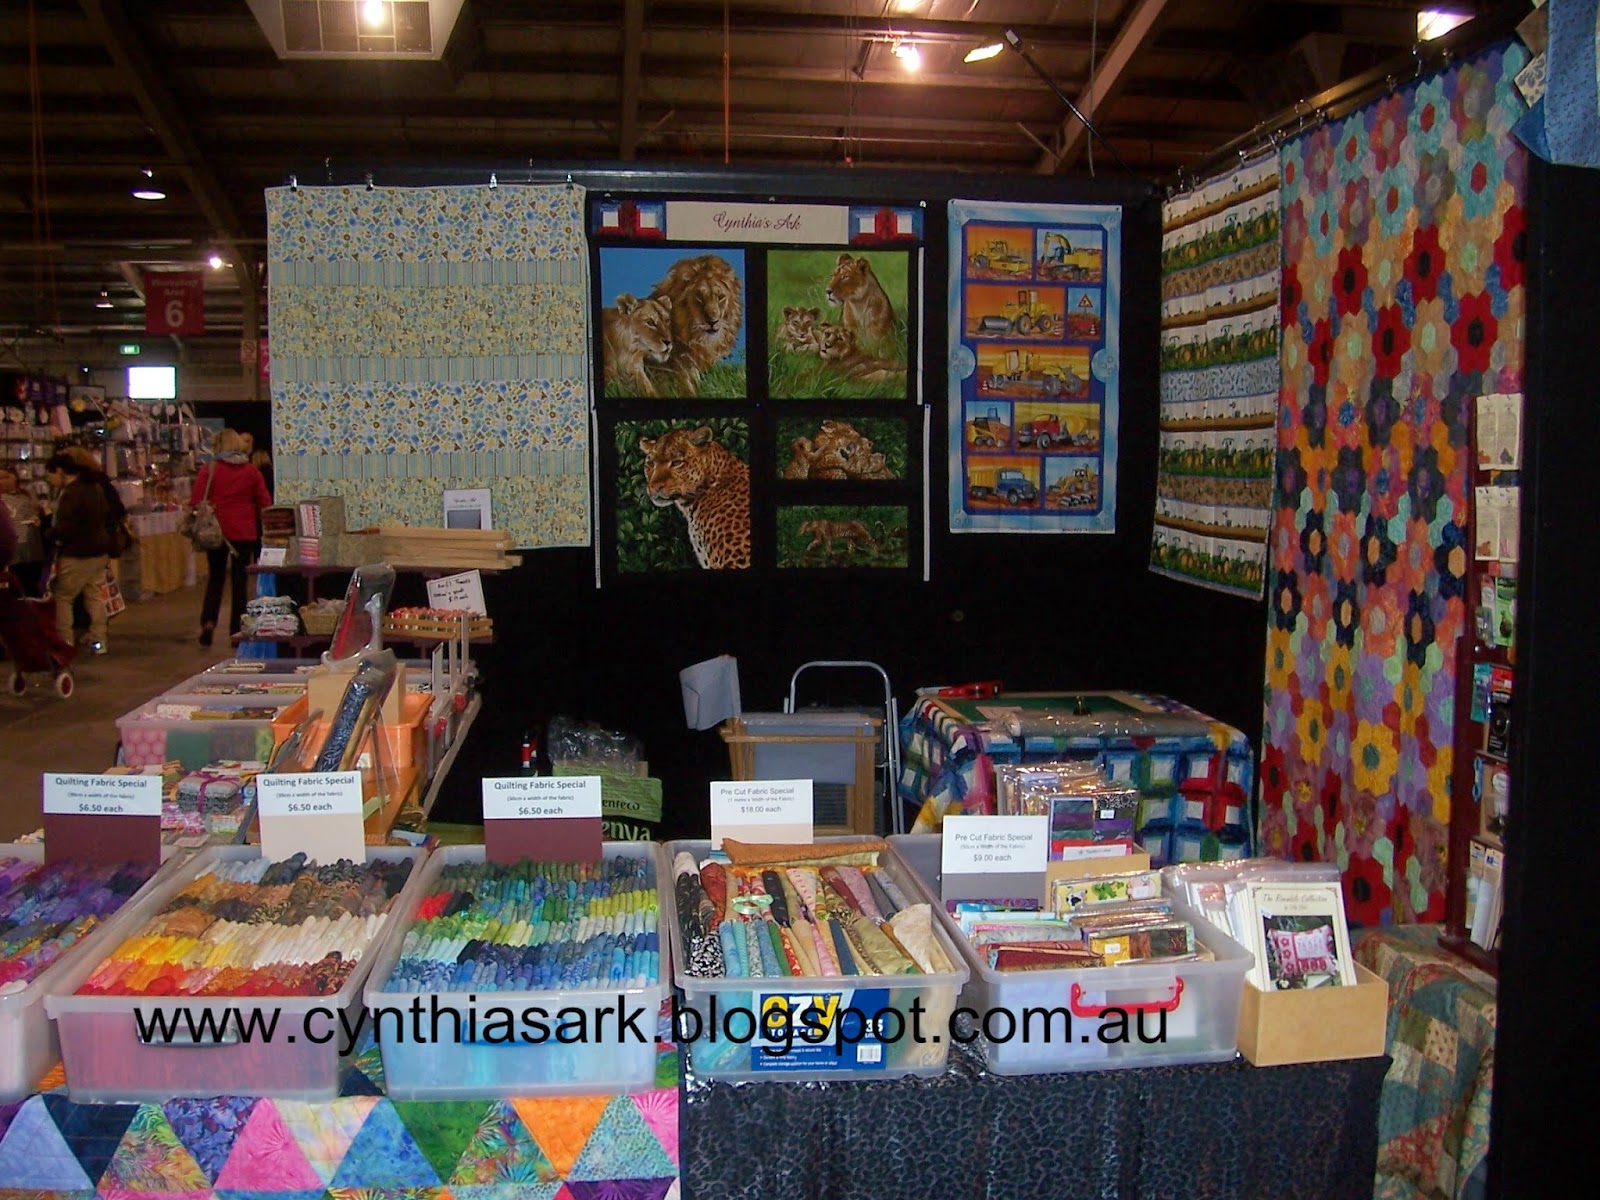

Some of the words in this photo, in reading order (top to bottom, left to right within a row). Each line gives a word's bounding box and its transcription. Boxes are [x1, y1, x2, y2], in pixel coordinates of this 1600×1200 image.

[713, 210, 772, 233] Cynthia's
[773, 213, 802, 230] Ark
[164, 300, 185, 328] 6
[55, 777, 89, 787] Quilting
[91, 778, 116, 787] Fabric
[118, 779, 147, 788] Special
[263, 778, 296, 787] Quilting
[298, 777, 323, 786] Fabric
[325, 776, 355, 786] Special
[494, 781, 528, 791] Quilting
[530, 781, 555, 789] Fabric
[557, 780, 586, 790] Special
[769, 787, 794, 795] Special
[79, 803, 102, 813] $6.50
[104, 804, 123, 813] each
[288, 803, 312, 812] $6.50
[313, 802, 333, 811] each
[518, 806, 542, 815] $6.50
[543, 806, 563, 814] each
[741, 806, 764, 814] $18.00
[1007, 833, 1033, 842] Special
[973, 854, 993, 862] $9.00
